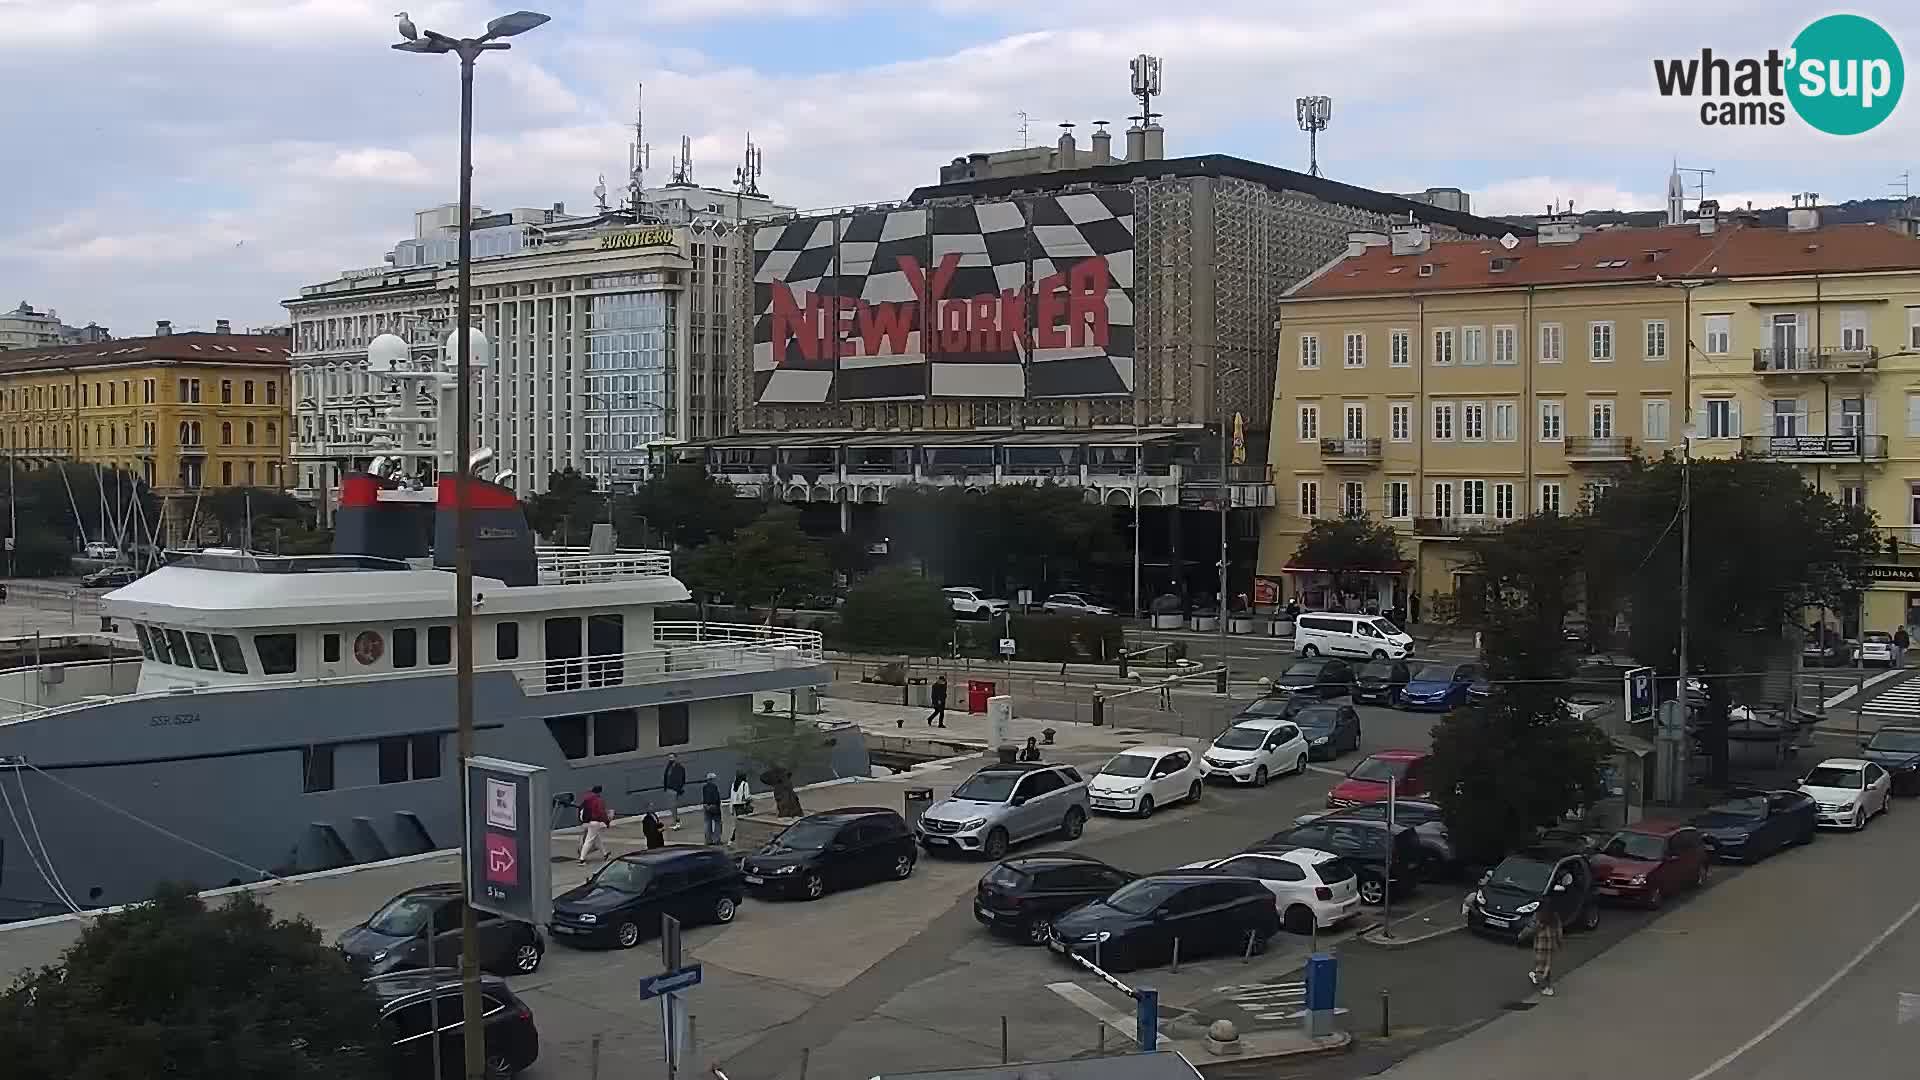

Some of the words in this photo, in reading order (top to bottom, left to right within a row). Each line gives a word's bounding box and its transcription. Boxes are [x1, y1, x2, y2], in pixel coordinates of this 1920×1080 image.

[772, 278, 921, 362] NEW
[897, 252, 1110, 352] YORKER
[1867, 569, 1916, 578] JULIANA
[487, 886, 493, 896] 5
[495, 888, 506, 899] km
